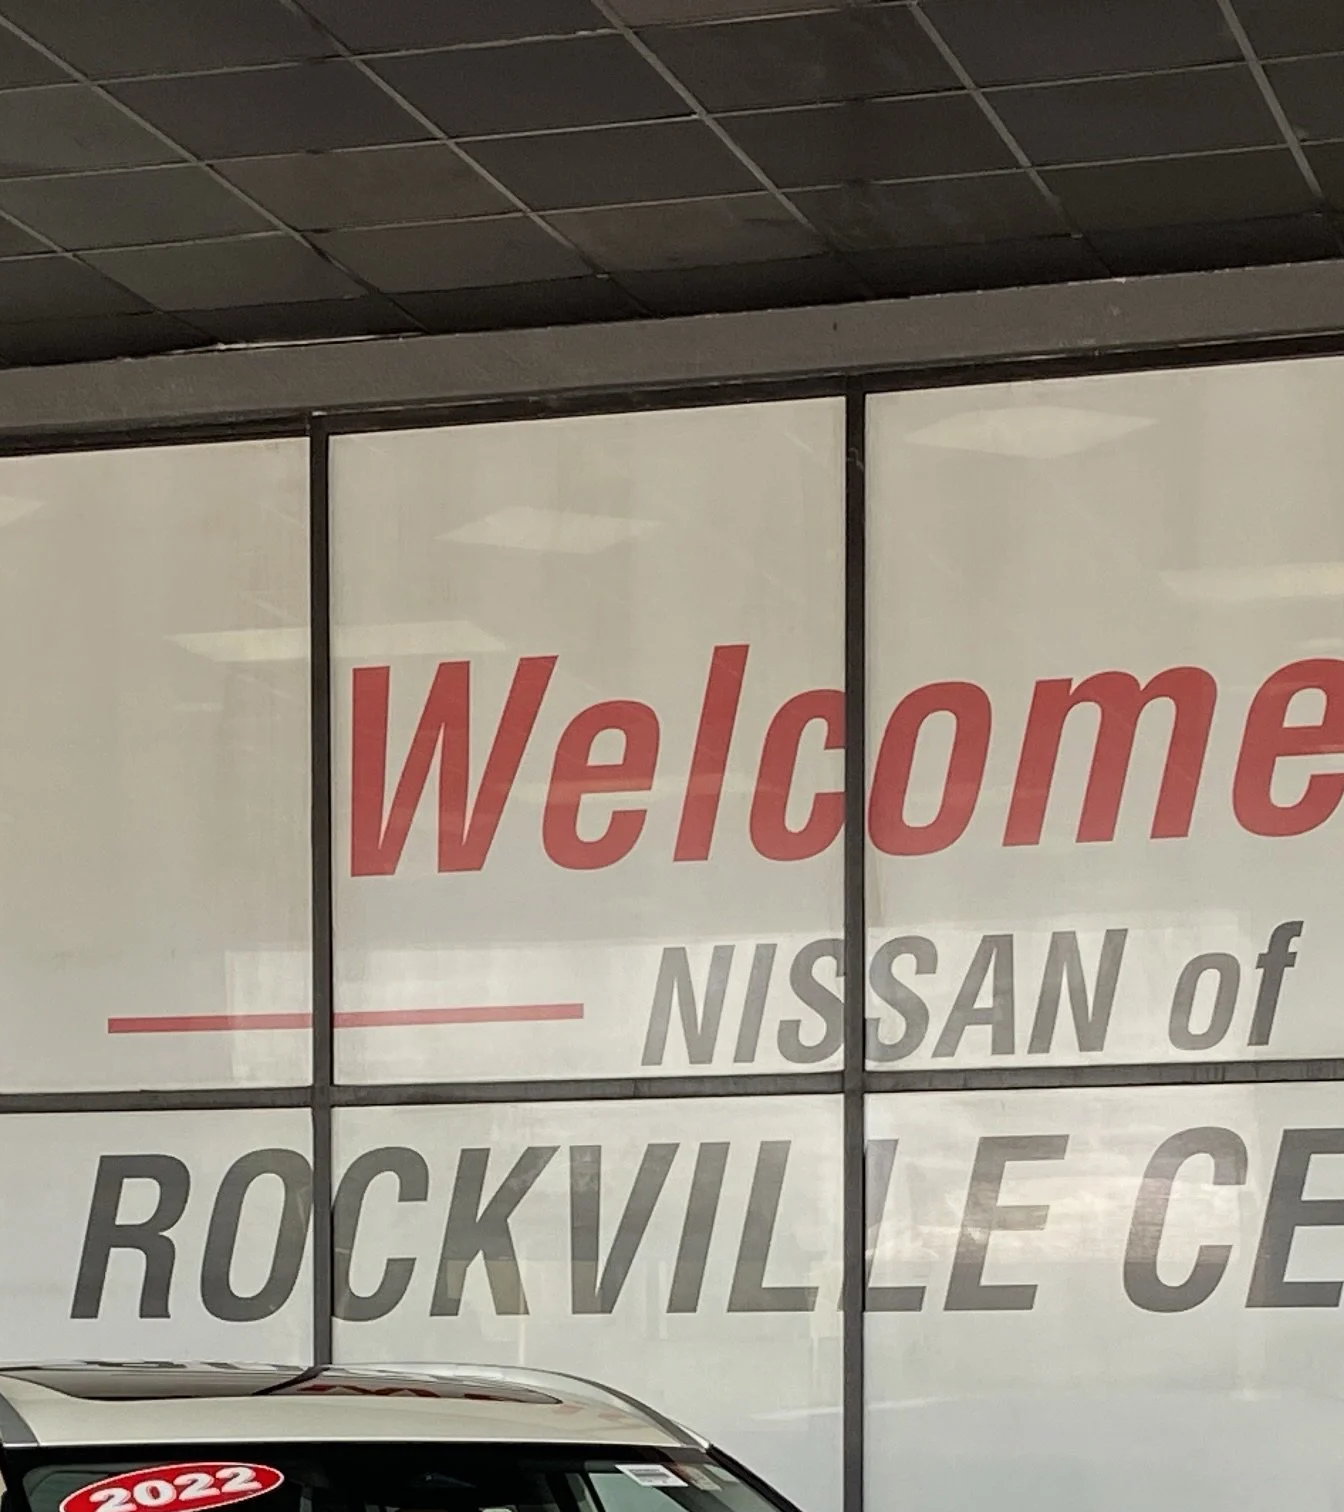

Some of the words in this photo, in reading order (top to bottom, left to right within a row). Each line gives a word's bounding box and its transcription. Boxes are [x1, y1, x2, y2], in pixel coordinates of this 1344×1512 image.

[640, 927, 1129, 1067] NISSAN
[1167, 920, 1303, 1052] of
[70, 1134, 1070, 1323] ROCKVILLE
